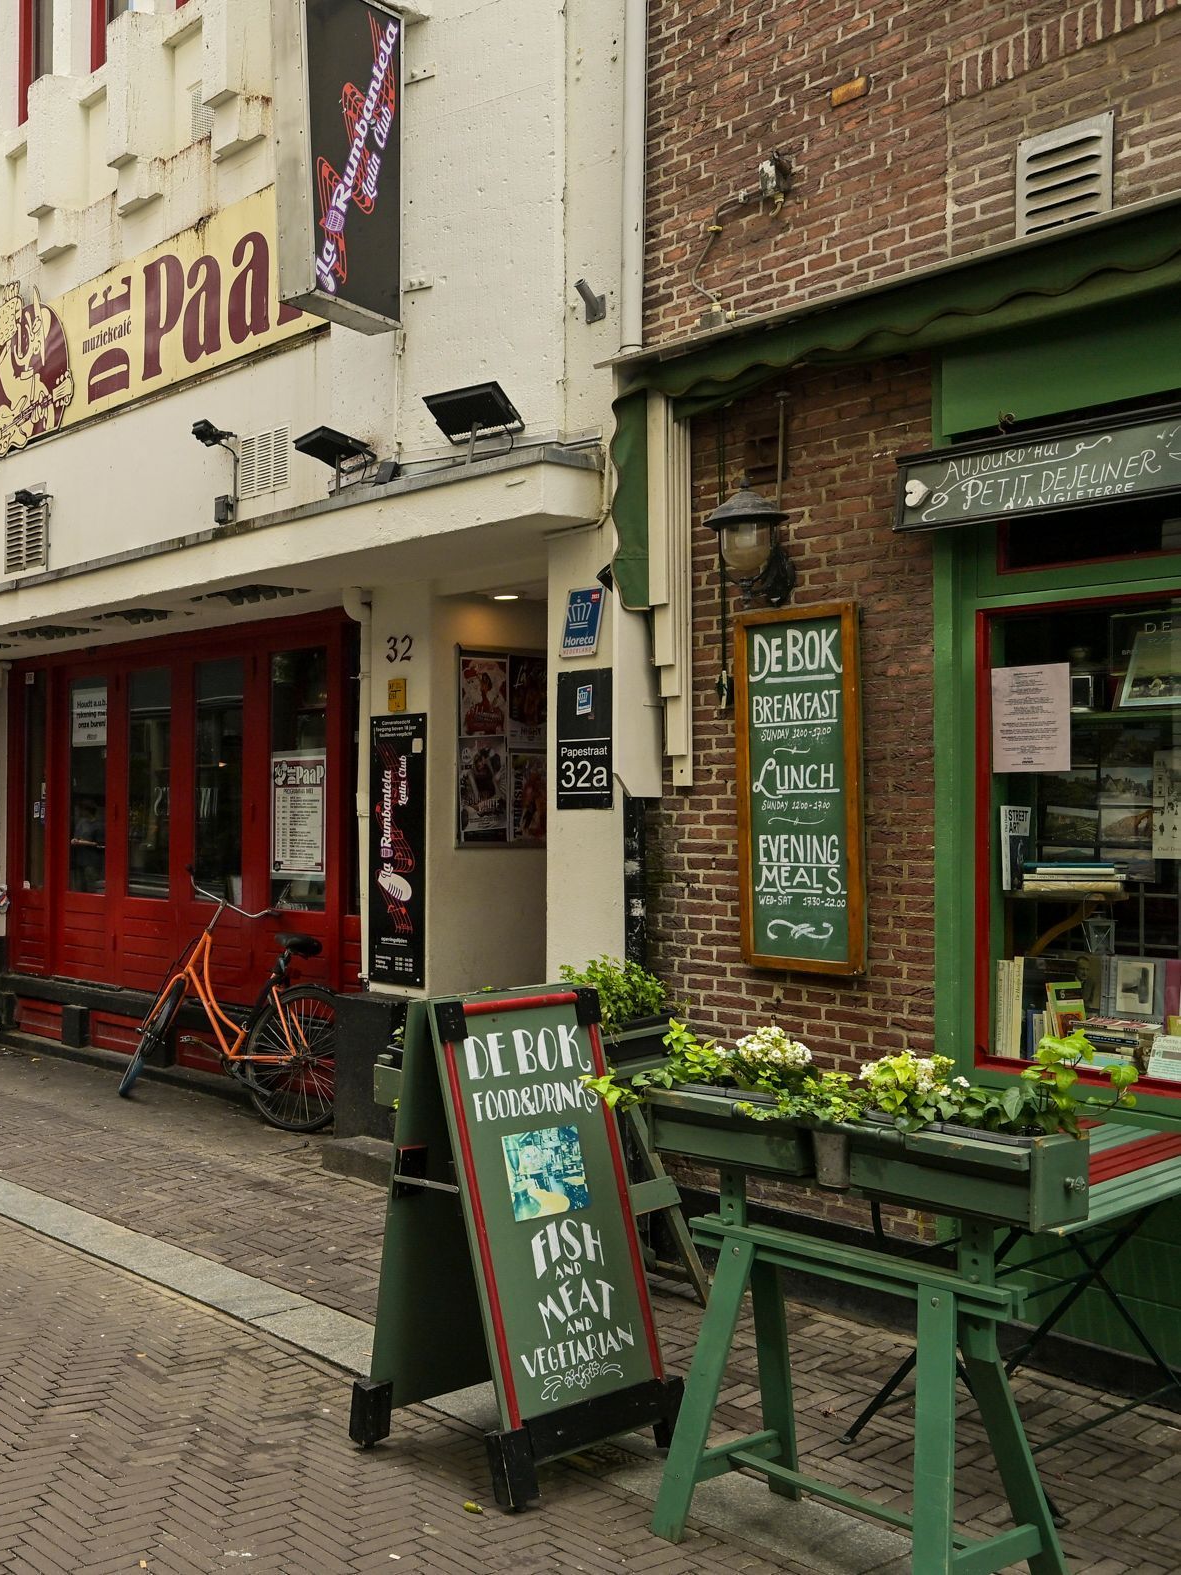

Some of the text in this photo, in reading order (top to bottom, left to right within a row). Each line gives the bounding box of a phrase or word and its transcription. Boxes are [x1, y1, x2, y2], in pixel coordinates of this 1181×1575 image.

[362, 105, 393, 200] Latin Club
[385, 634, 414, 663] 32
[564, 635, 594, 646] Horeca
[748, 628, 843, 682] DE BOK
[753, 689, 841, 725] BREAKFAST
[761, 727, 789, 742] SUNDAY
[560, 745, 608, 758] Papestraat
[561, 760, 608, 788] 32a
[753, 757, 835, 801] LUNCH
[380, 769, 393, 849] Rumbantela
[761, 799, 789, 811] SUNDAY
[1007, 809, 1029, 822] STREET
[758, 833, 840, 863] EVENING
[758, 895, 793, 905] WED-SAT
[463, 1024, 592, 1080] DE BOK
[530, 1218, 605, 1280] FISH
[555, 1261, 582, 1281] AND
[538, 1279, 615, 1340] MEAT
[565, 1316, 592, 1336] AND
[520, 1323, 635, 1378] VEGETARIAN
